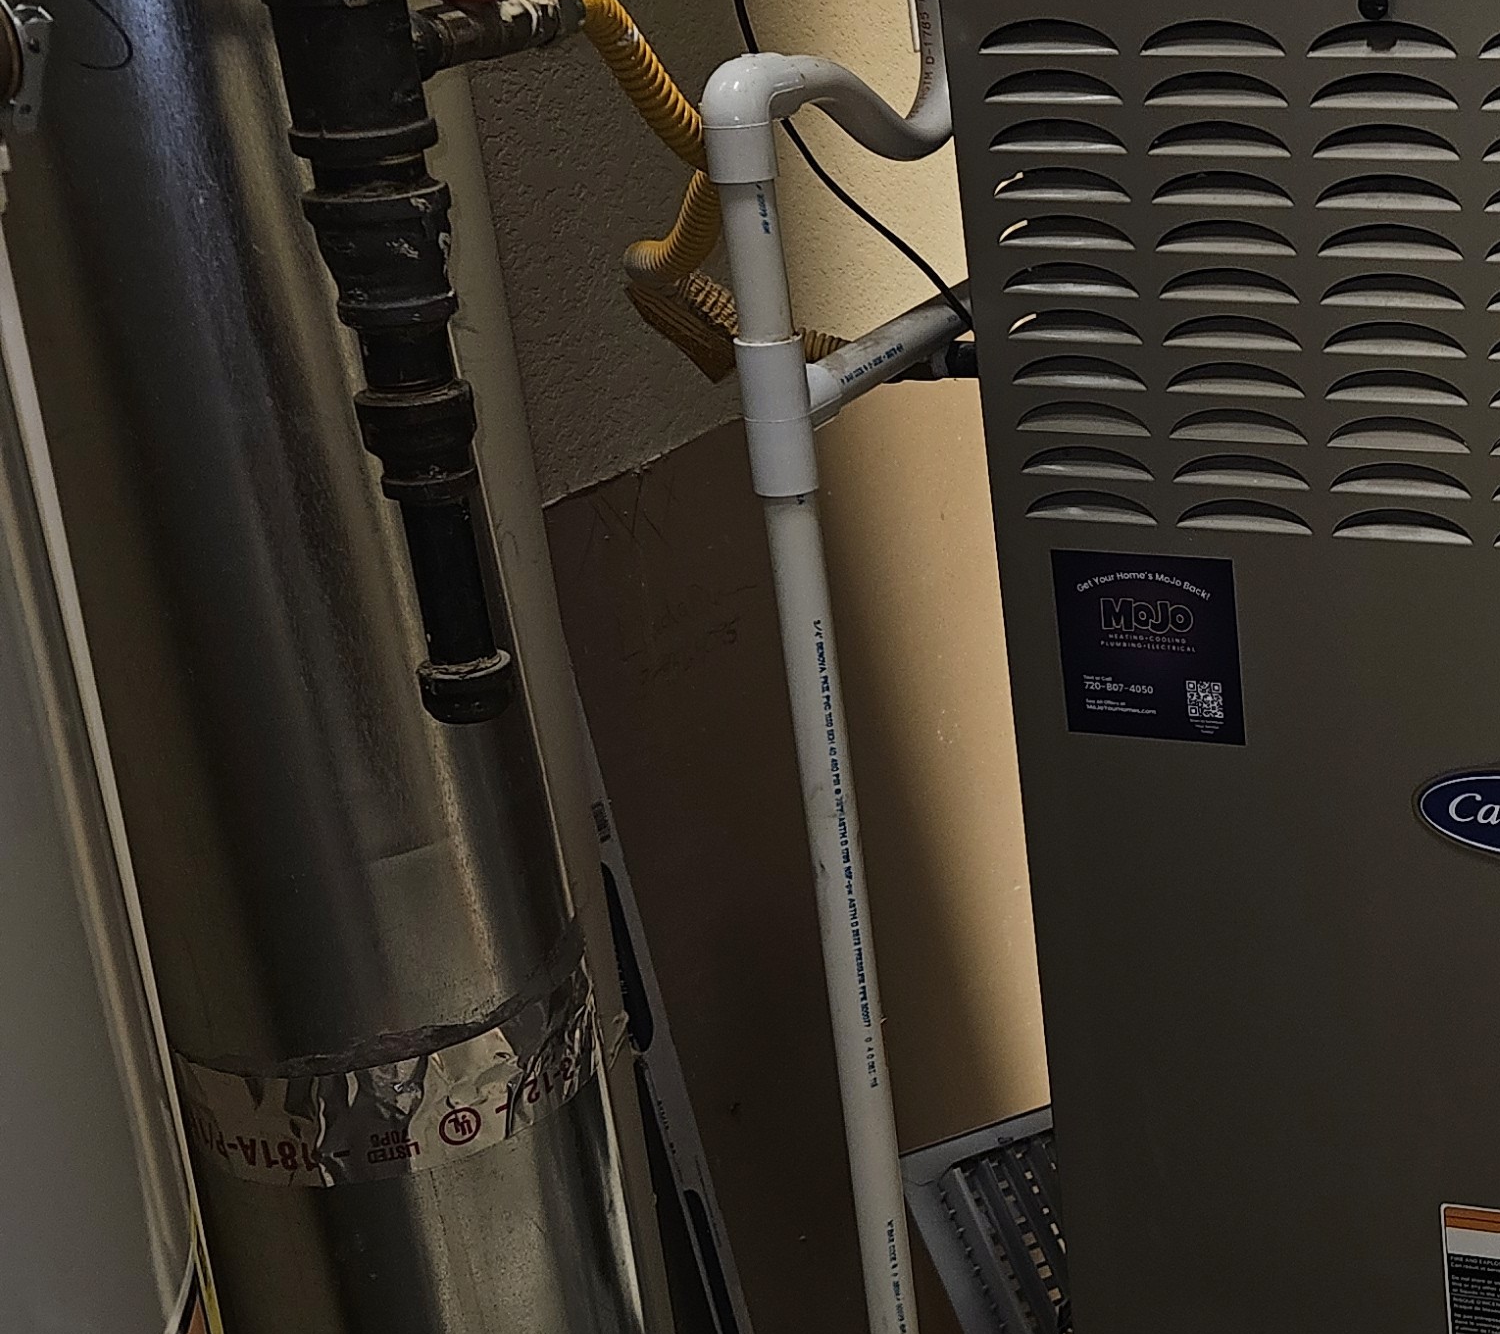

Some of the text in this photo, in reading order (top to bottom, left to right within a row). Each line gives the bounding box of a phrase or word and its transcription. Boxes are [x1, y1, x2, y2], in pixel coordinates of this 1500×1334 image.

[1076, 579, 1094, 593] Get
[1092, 573, 1115, 586] Your
[1116, 571, 1154, 581] Home's
[1183, 581, 1212, 601] Back!
[1084, 681, 1154, 695] 720-807-4050
